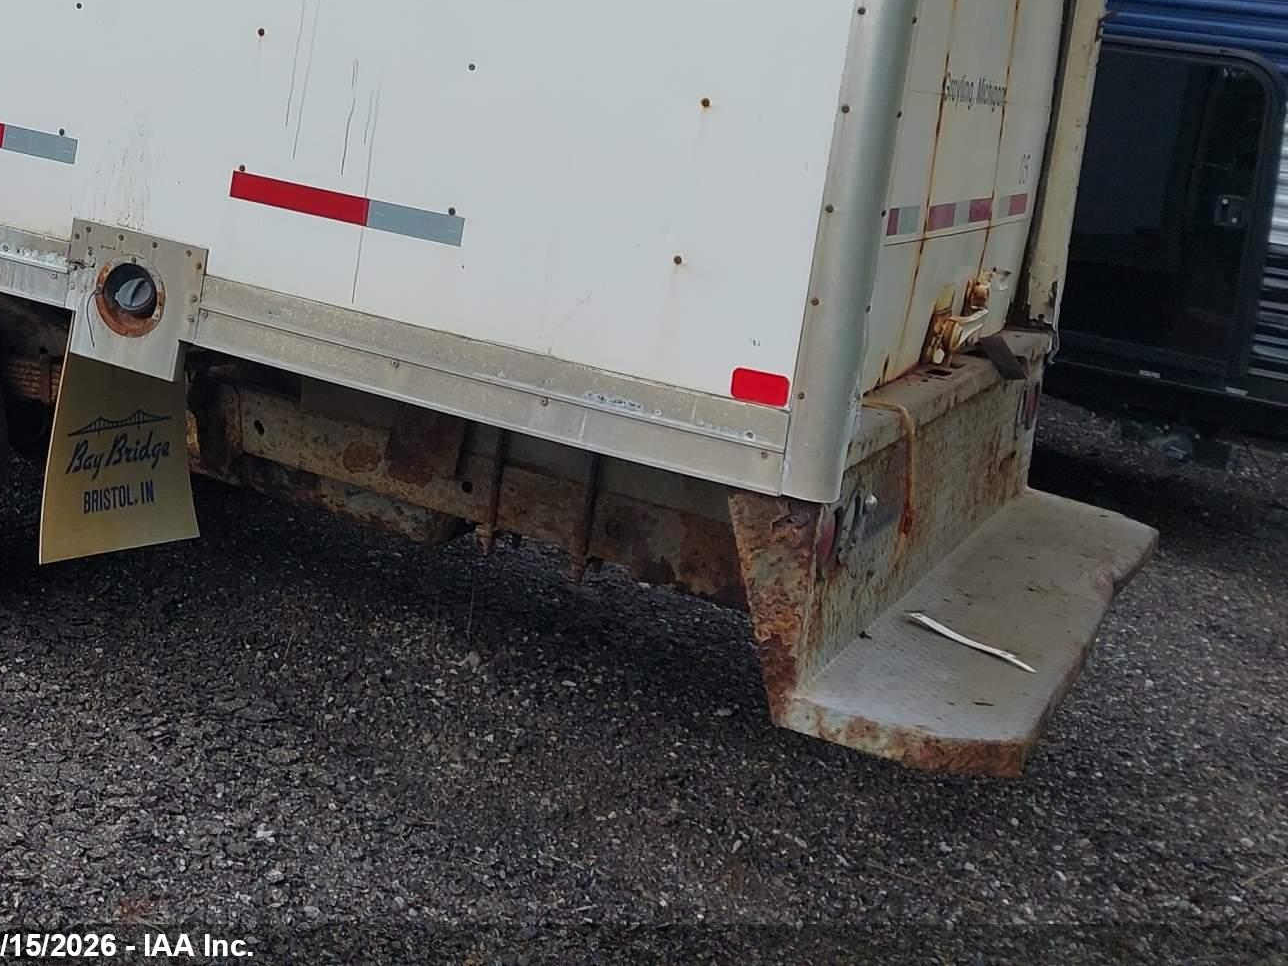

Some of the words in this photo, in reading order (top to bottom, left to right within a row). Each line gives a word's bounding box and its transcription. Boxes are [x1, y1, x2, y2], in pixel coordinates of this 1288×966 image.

[65, 439, 104, 481] Bay
[105, 430, 171, 470] Bridge
[141, 480, 155, 504] IN
